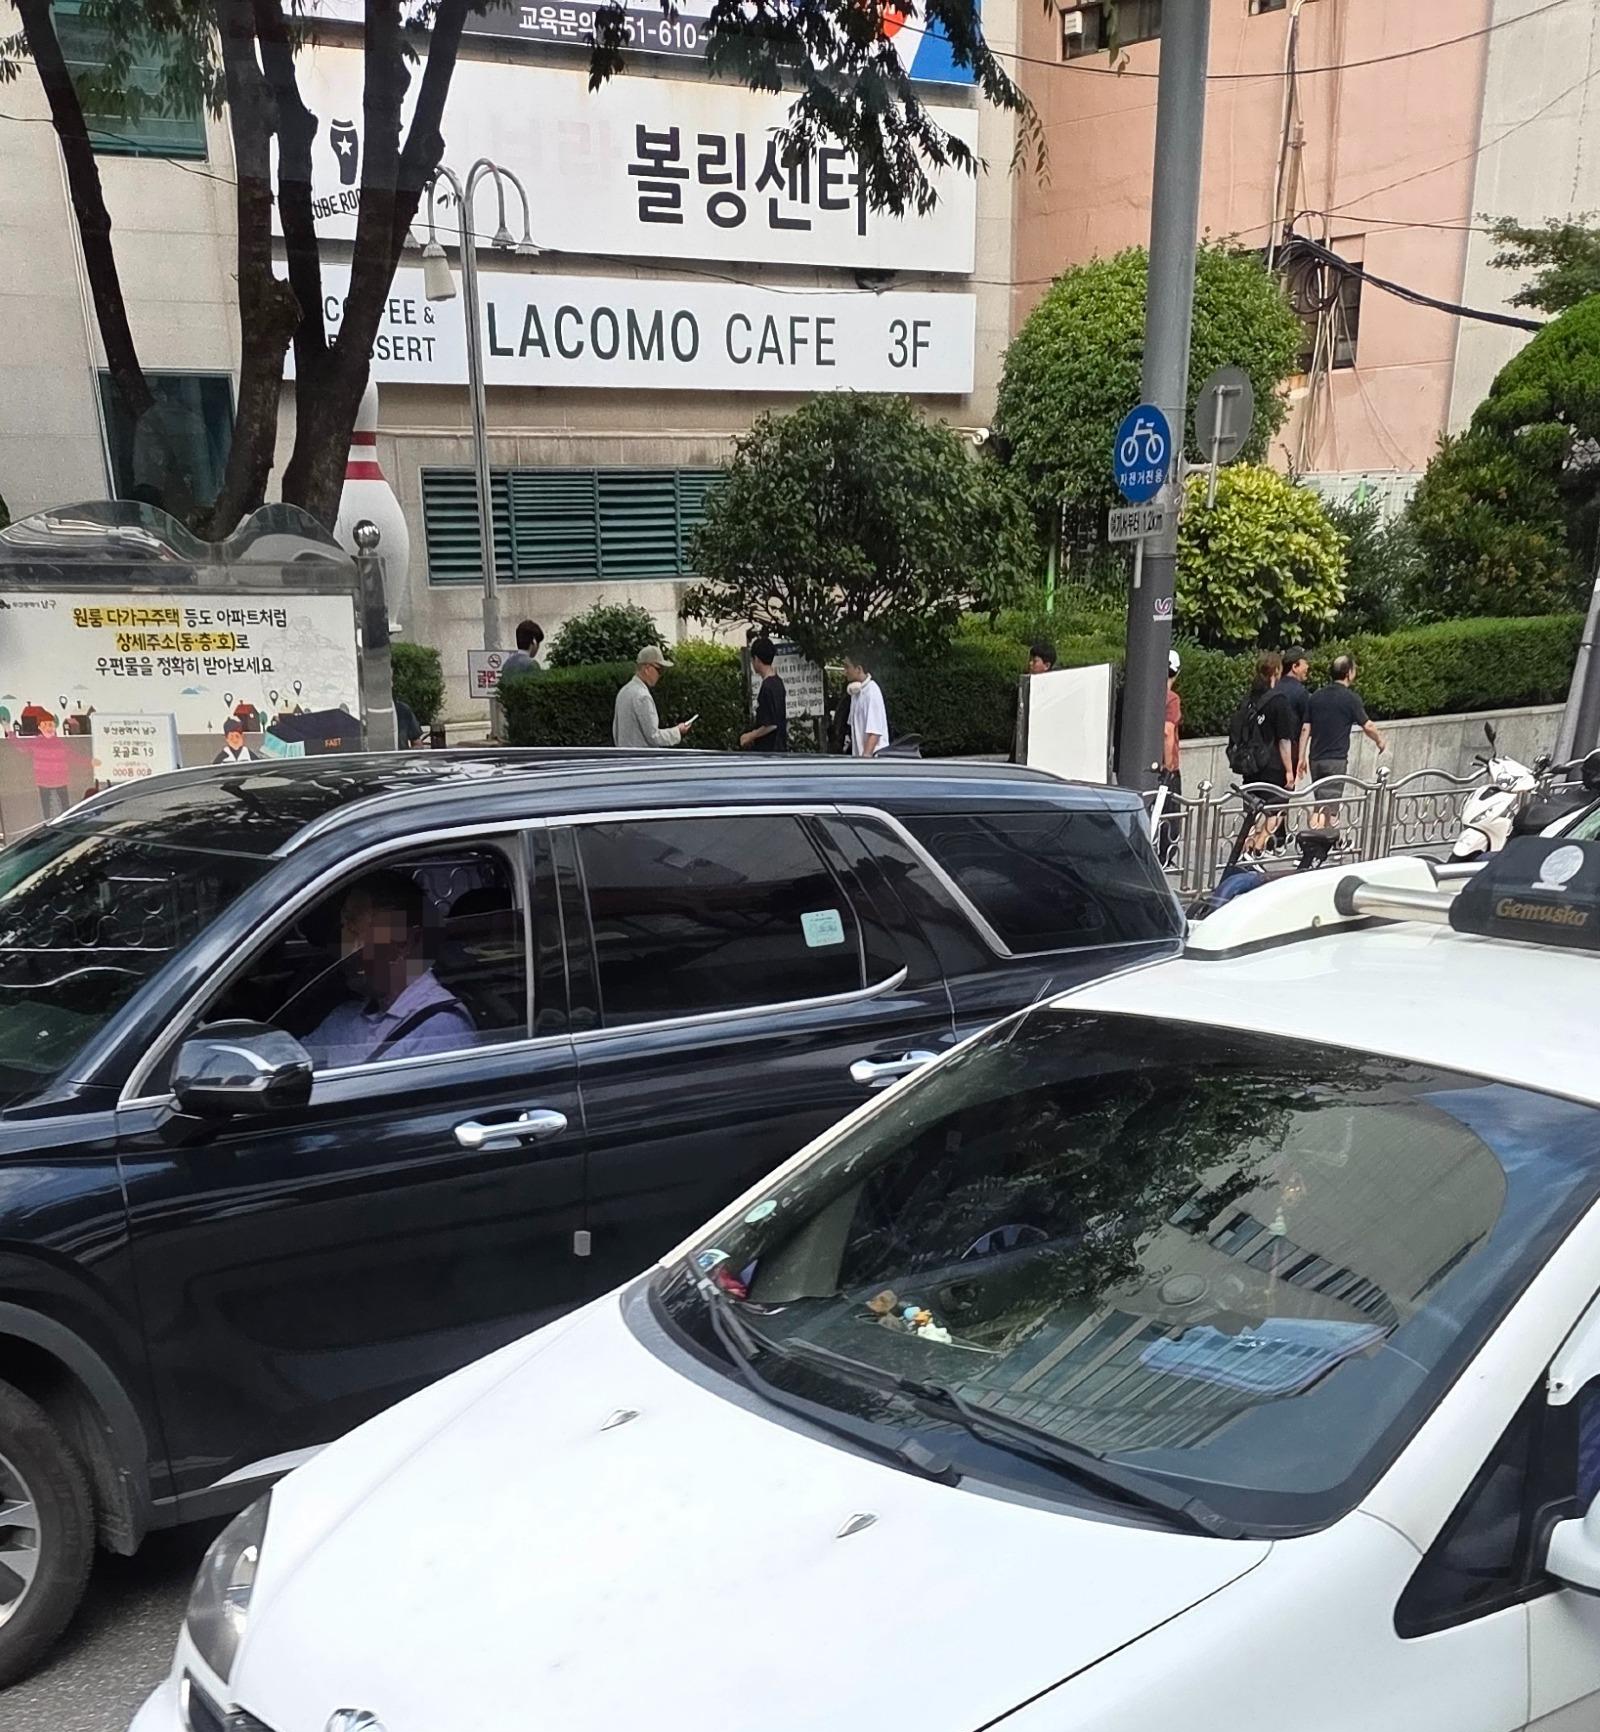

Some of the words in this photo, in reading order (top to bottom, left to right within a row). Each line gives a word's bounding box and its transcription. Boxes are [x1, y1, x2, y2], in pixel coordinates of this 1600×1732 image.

[518, 6, 597, 38] 교육문의
[608, 15, 709, 49] 51-610-
[627, 124, 867, 236] 볼링센터
[311, 194, 338, 220] UBE
[324, 295, 418, 325] CEE
[423, 306, 435, 325] &
[486, 301, 701, 363] LACOMO
[725, 312, 838, 367] CAFE
[887, 319, 932, 369] 3F
[327, 333, 436, 362] SERT
[1119, 467, 1163, 487] 자전거전용
[73, 608, 102, 628] 원룸
[107, 608, 180, 627] 다가구주택
[184, 608, 214, 628] 등도
[216, 608, 287, 628] 아파트처럼
[116, 632, 251, 652] 상세주소(동·층·호)로
[95, 656, 153, 676] 우편물을
[156, 656, 200, 676] 정확히
[203, 656, 275, 676] 받아보세요
[143, 747, 154, 757] 19
[324, 737, 343, 749] FAST
